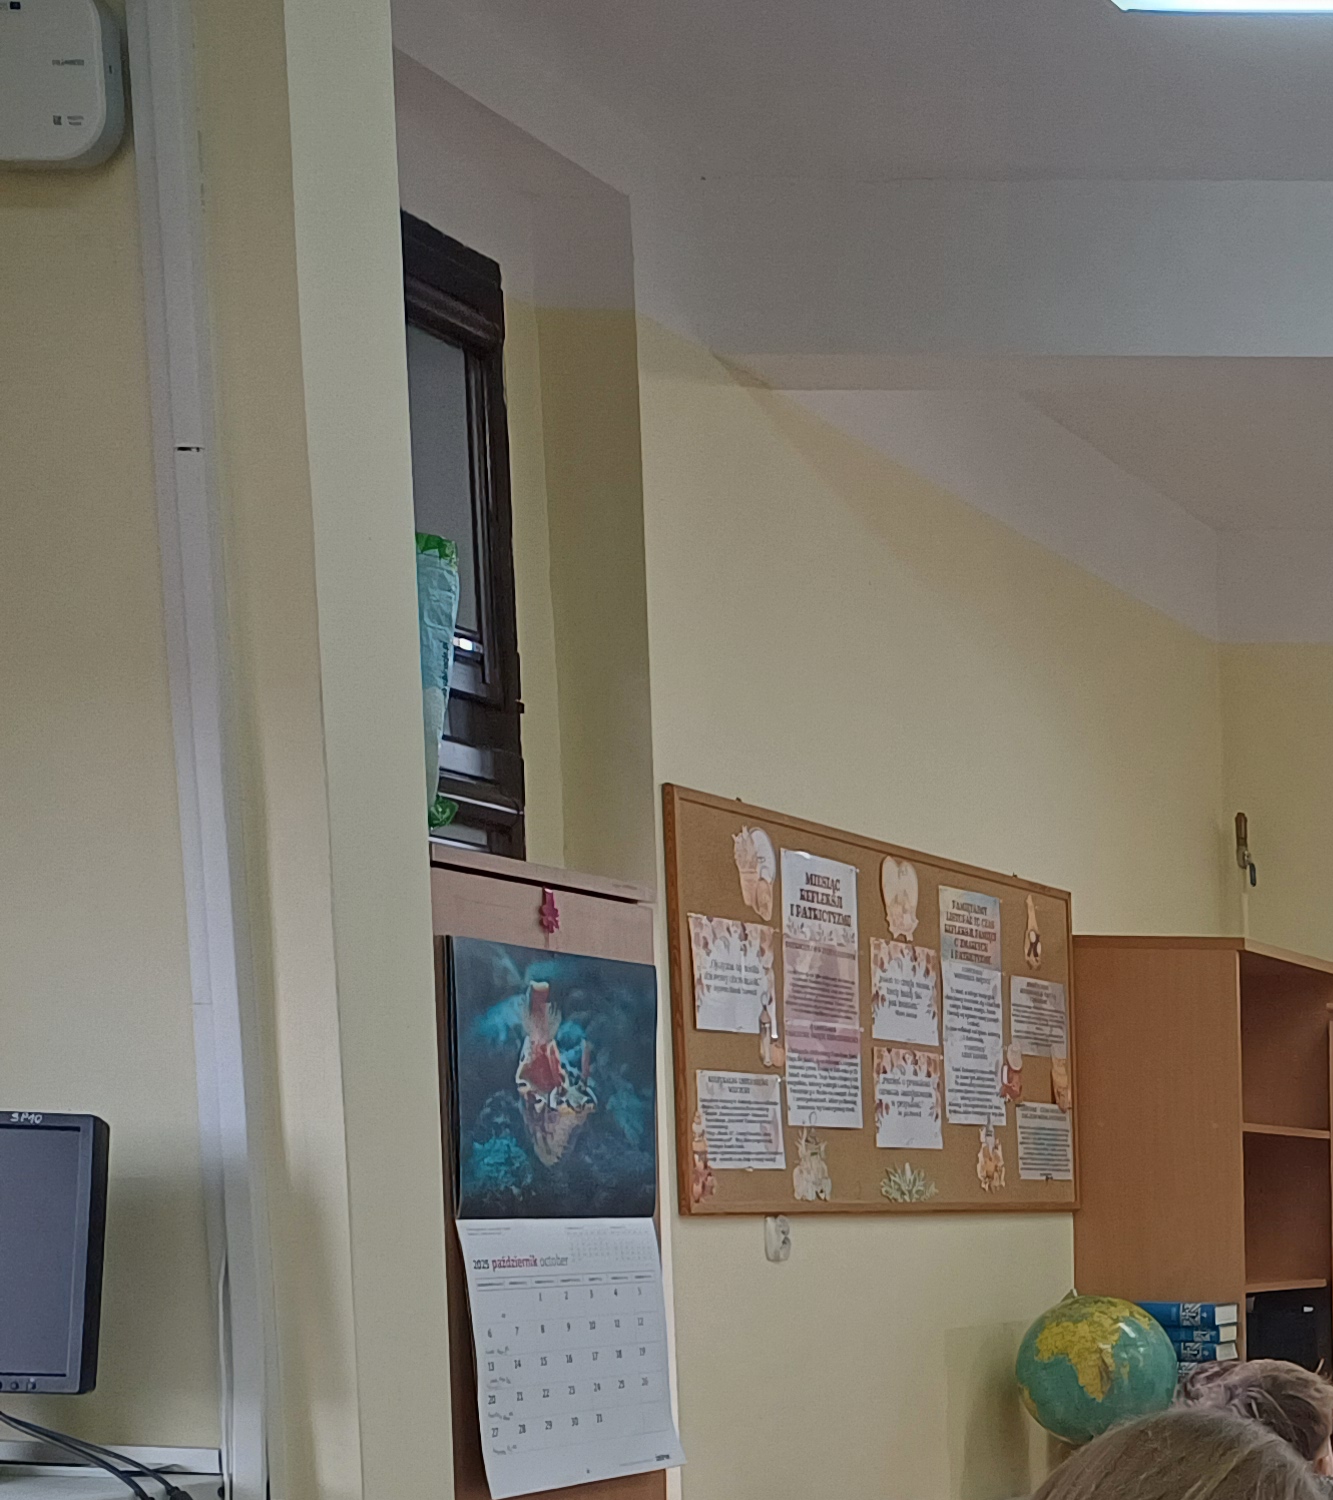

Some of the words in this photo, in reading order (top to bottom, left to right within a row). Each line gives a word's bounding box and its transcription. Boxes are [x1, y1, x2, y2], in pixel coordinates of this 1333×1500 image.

[473, 1259, 489, 1270] 2025
[492, 1255, 538, 1271] październik
[540, 1253, 568, 1267] october
